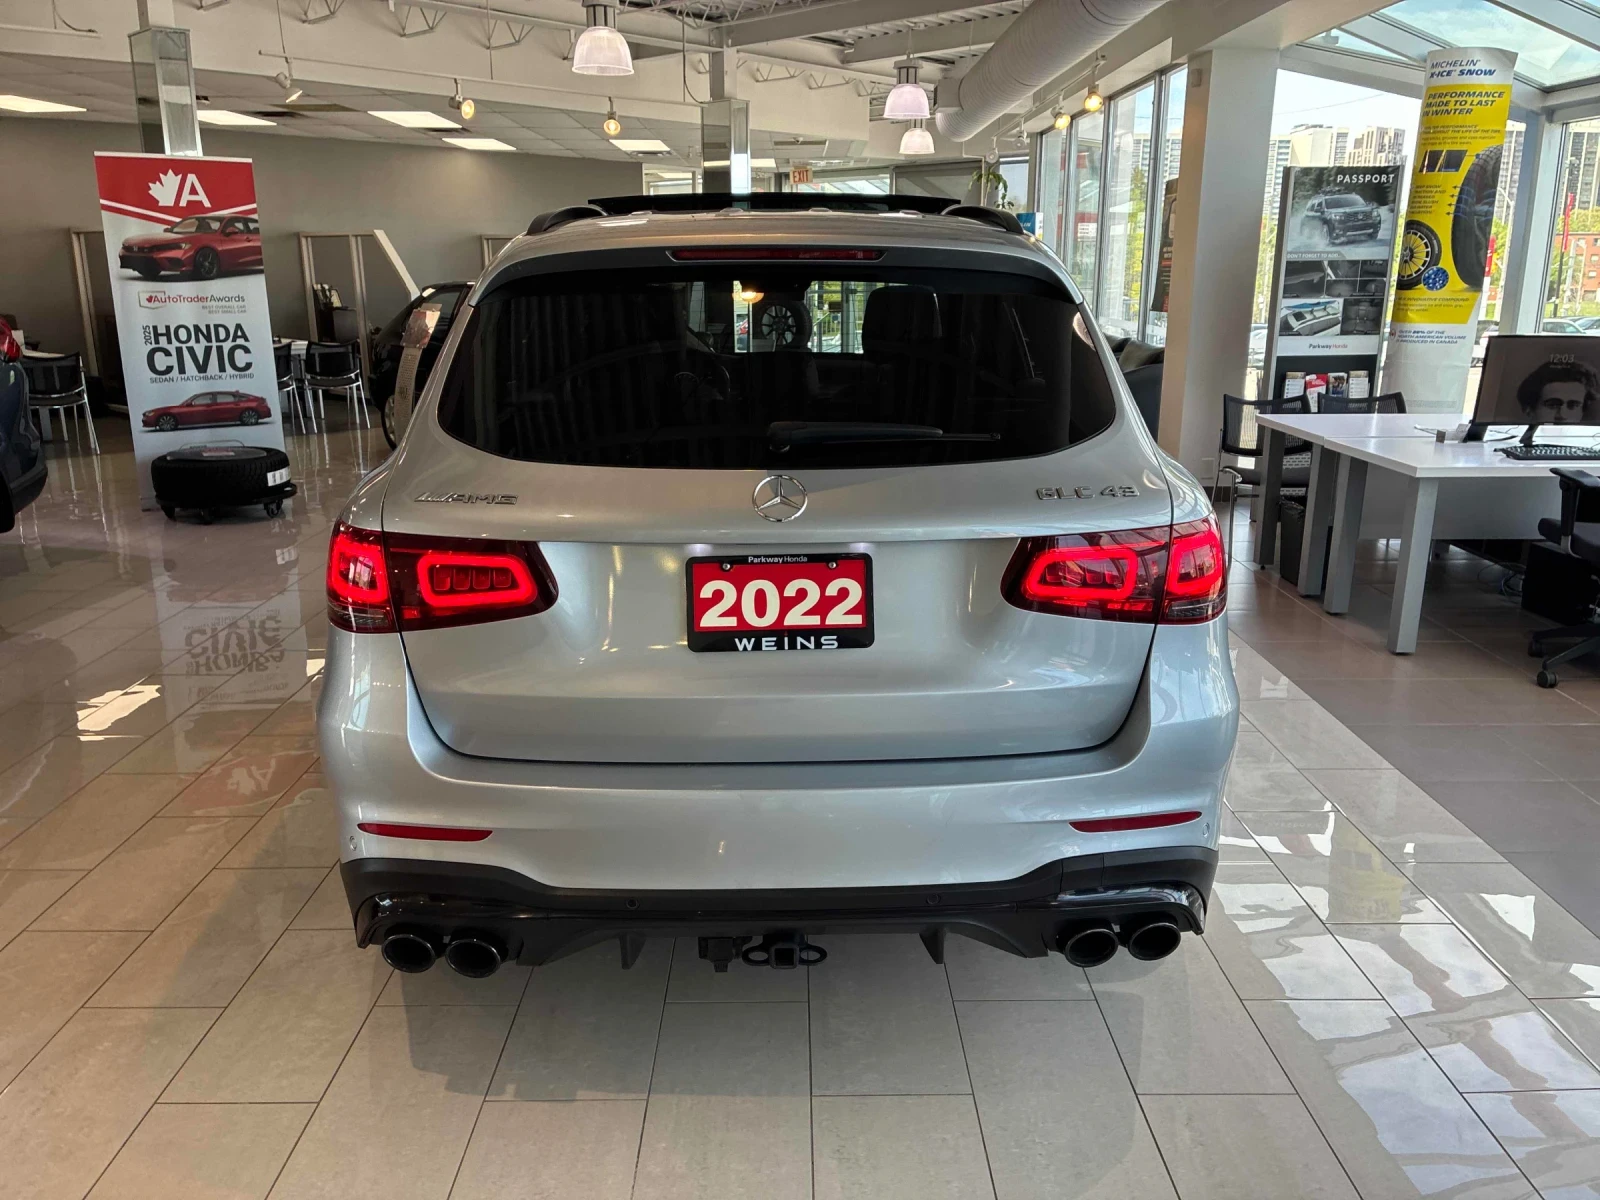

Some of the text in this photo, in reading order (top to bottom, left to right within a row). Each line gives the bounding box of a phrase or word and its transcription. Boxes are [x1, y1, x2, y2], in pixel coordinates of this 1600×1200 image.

[1431, 59, 1478, 69] MICHELIN
[1428, 91, 1505, 100] PERFORMANCE
[1425, 100, 1450, 109] MADE
[1431, 108, 1473, 116] WINTER
[792, 169, 809, 183] EXIT
[1336, 174, 1395, 184] PASSPORT
[178, 173, 212, 208] A
[142, 325, 152, 346] 2025
[152, 323, 250, 345] HONDA
[146, 344, 253, 376] CIVIC
[180, 375, 224, 383] HATCHBACK
[440, 492, 519, 505] AMG
[1036, 485, 1140, 500] GLC 43
[748, 555, 808, 564] Parkway Honda
[699, 578, 863, 628] 2022
